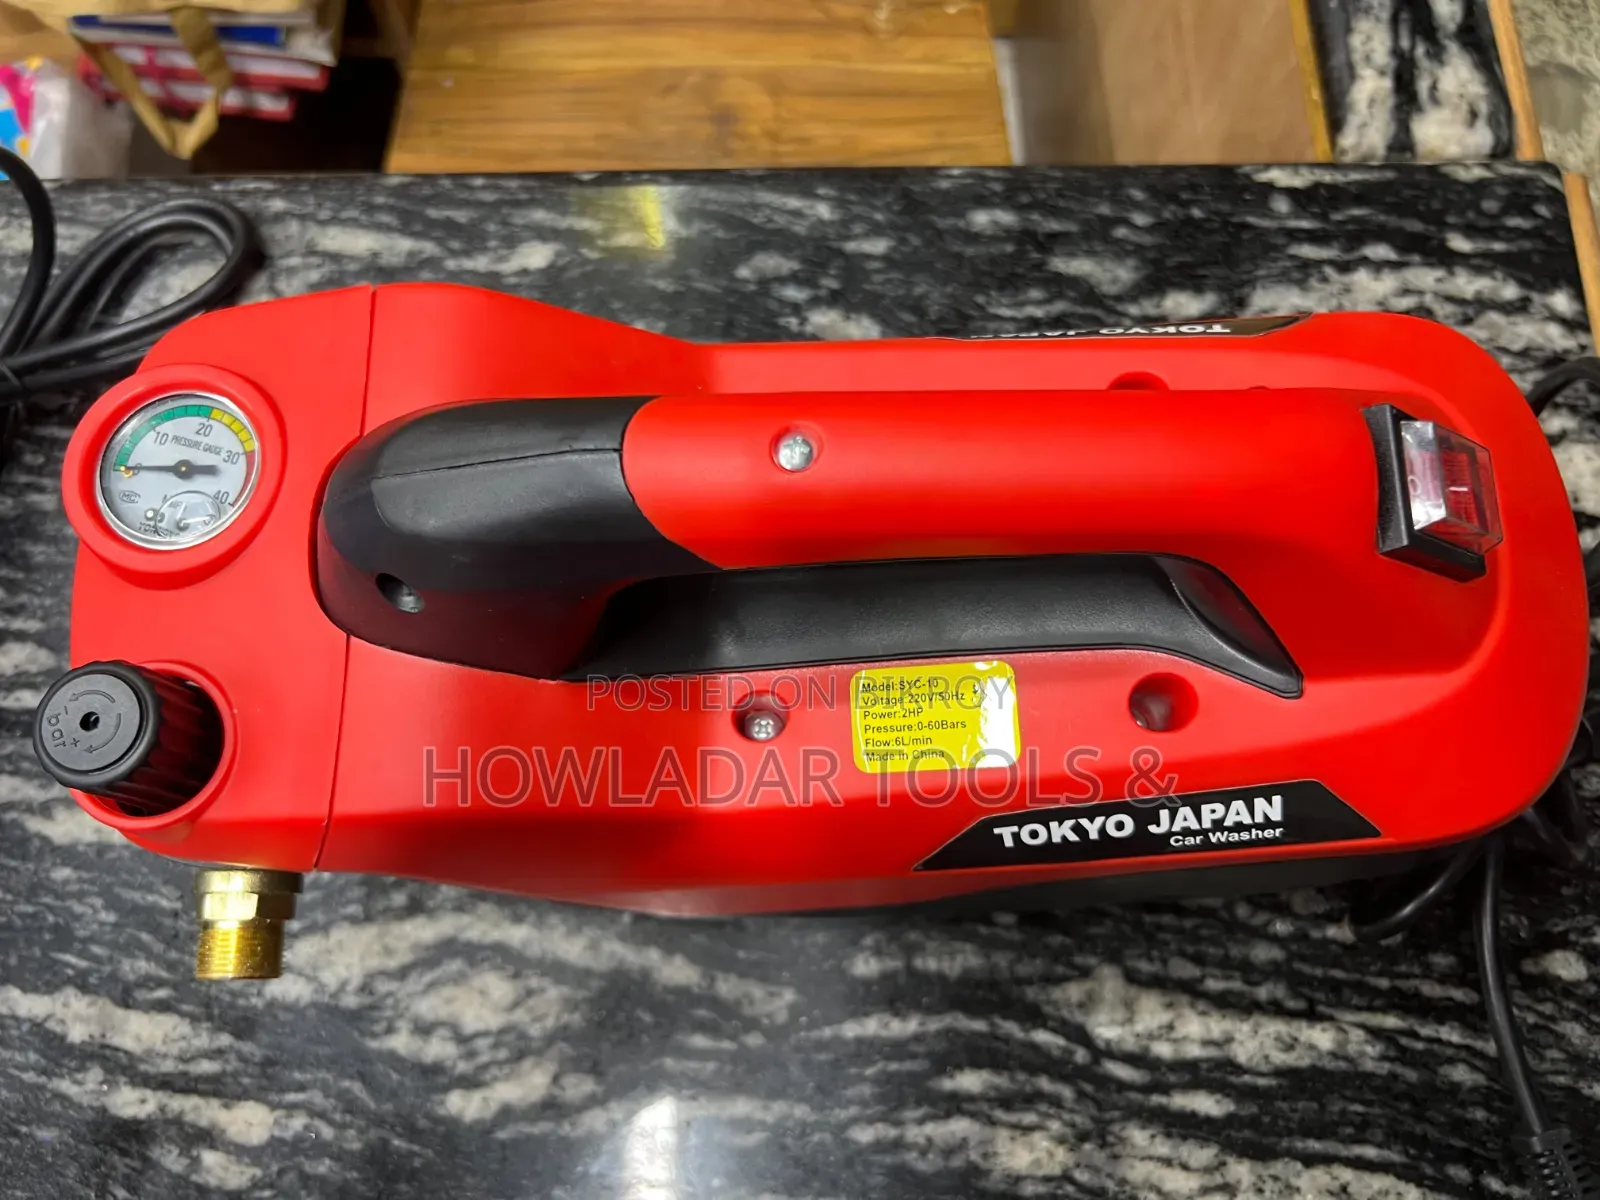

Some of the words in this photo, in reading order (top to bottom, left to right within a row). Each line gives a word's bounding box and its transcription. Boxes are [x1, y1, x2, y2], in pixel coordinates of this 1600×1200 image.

[1098, 324, 1231, 335] TOKYO
[195, 422, 214, 437] 20
[154, 431, 169, 446] 10
[170, 434, 204, 451] PRESSURE
[202, 443, 225, 457] GAUGE
[222, 449, 241, 465] 30
[213, 489, 230, 505] 40
[863, 708, 924, 720] Power:2HP
[864, 720, 967, 734] Pressure:0-60Bars
[864, 736, 933, 747] Flow:6L/min
[865, 751, 895, 762] Made
[898, 750, 909, 760] in
[912, 749, 945, 760] China
[994, 813, 1135, 849] TOKYO
[1147, 794, 1284, 835] JAPAN
[1169, 832, 1204, 848] Car
[1205, 826, 1285, 844] Washer
